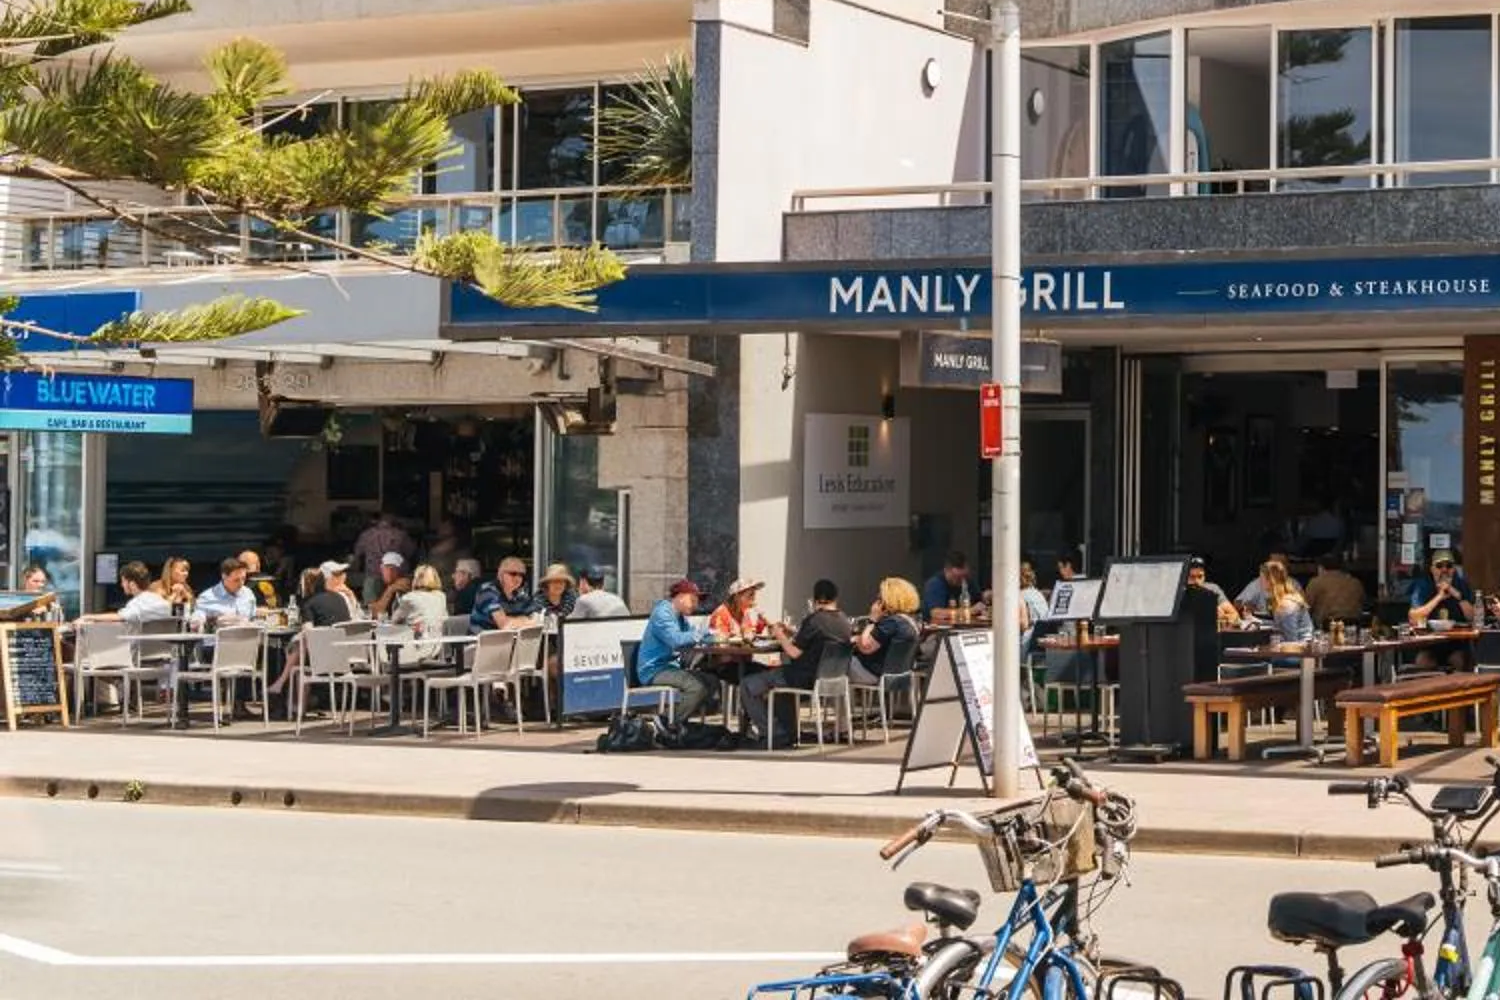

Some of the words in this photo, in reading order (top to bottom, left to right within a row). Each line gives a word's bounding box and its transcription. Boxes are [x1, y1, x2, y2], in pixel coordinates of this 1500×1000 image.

[829, 274, 981, 313] MANLY
[1018, 271, 1125, 311] RILL
[1227, 283, 1320, 299] SEAFOOD
[1329, 284, 1344, 297] &
[1354, 279, 1491, 296] STEAKHOUSE
[1479, 358, 1496, 422] GRILL
[1479, 434, 1496, 506] MANLY
